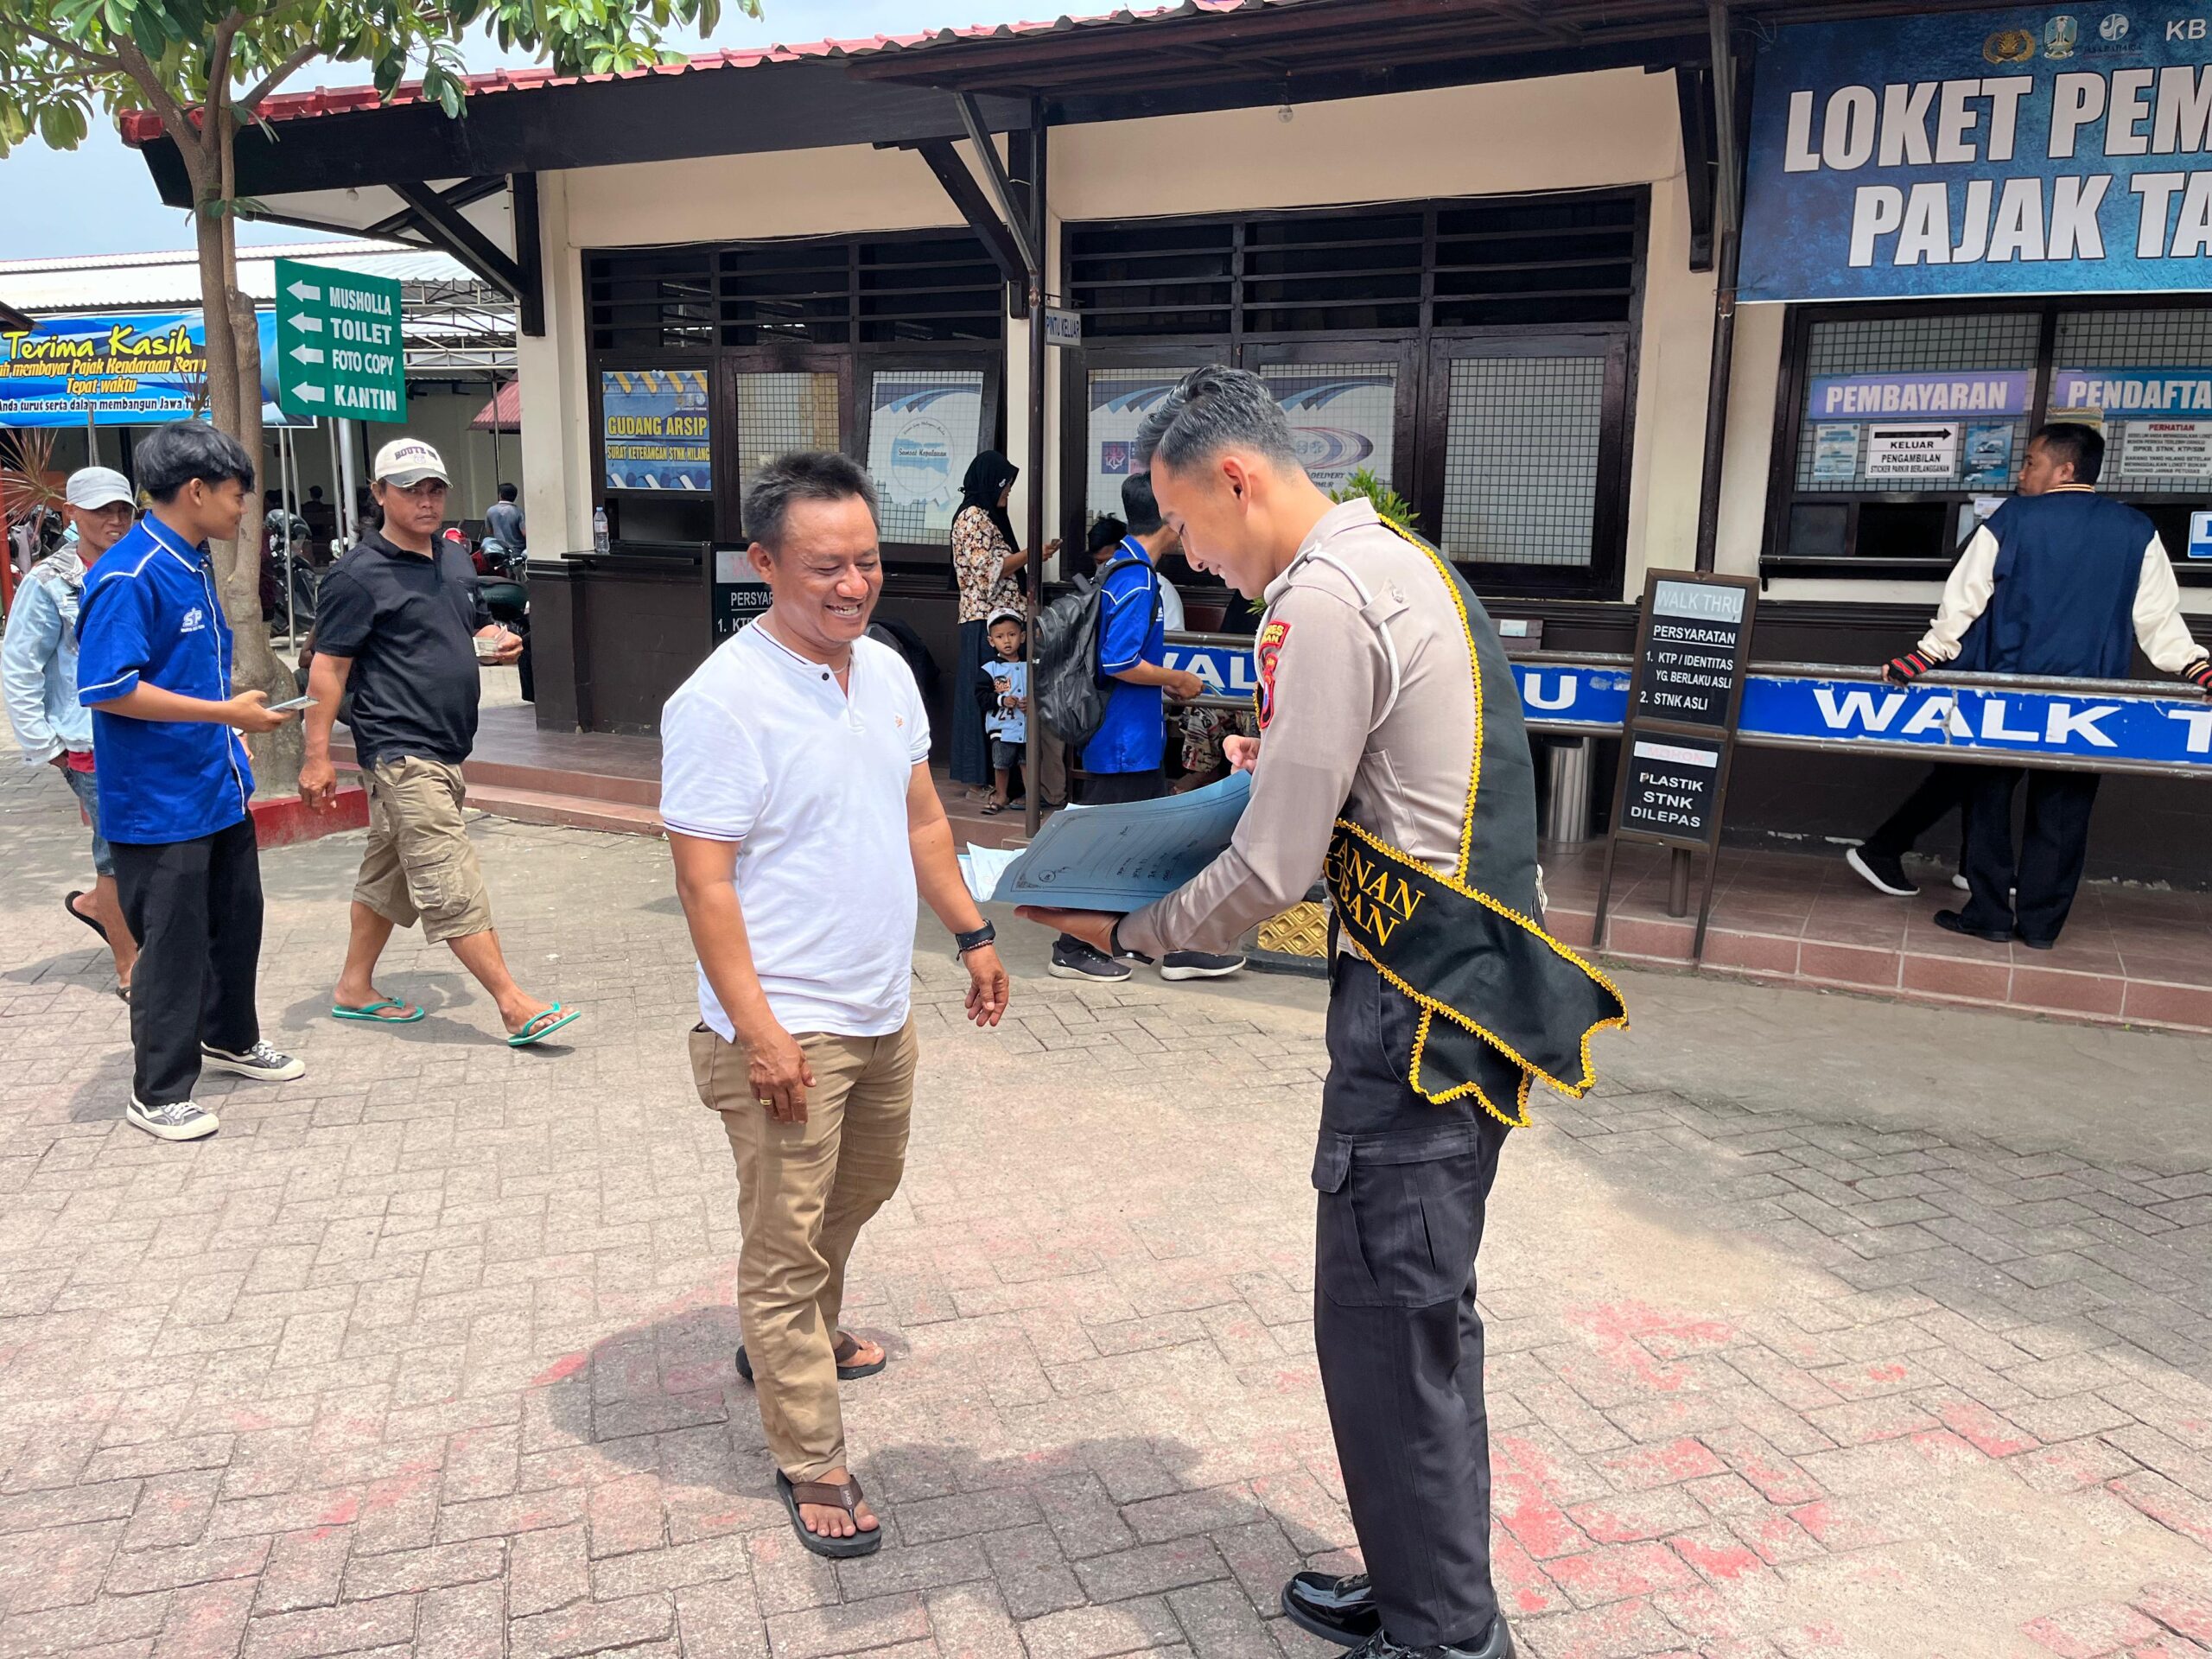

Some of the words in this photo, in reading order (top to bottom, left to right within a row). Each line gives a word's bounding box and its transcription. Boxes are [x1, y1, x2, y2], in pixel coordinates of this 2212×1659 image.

[2166, 19, 2206, 41] KB
[1784, 76, 2033, 172] LOKET
[2049, 65, 2212, 158] PEM
[1848, 175, 2113, 267] PAJAK
[2130, 170, 2212, 258] TA
[329, 286, 391, 316] MUSHOLLA
[330, 317, 392, 346] TOILET
[1046, 315, 1061, 336] PINTU
[1061, 318, 1080, 339] KELUAR
[3, 330, 94, 359] Terima
[109, 323, 192, 356] Kasih
[12, 360, 70, 378] membayar
[72, 358, 104, 377] Pajak
[105, 357, 171, 373] Kendaraan
[332, 349, 362, 372] FOTO
[365, 353, 394, 376] COPY
[67, 378, 98, 396] Tepat
[100, 376, 137, 393] waktu
[2067, 380, 2212, 409] PENDAFTA
[21, 400, 43, 411] turut
[46, 399, 67, 410] serta
[99, 398, 156, 411] membangun
[160, 398, 182, 410] Jawa
[334, 385, 397, 411] KANTIN
[1826, 382, 2007, 413] PEMBAYARAN
[607, 416, 662, 435] GUDANG
[666, 416, 707, 436] ARSIP
[607, 445, 626, 460] SURAT
[629, 446, 667, 460] KETERANGAN
[670, 447, 685, 461] STNK
[687, 447, 709, 461] HILANG
[1881, 454, 1942, 463] PENGAMBILAN
[1658, 590, 1699, 610] WALK
[1703, 594, 1744, 614] THRU
[718, 618, 727, 632] 1.
[1654, 625, 1736, 645] PERSYARATAN
[1646, 651, 1654, 662] 1.
[1658, 652, 1677, 664] KTP
[1684, 654, 1733, 671] IDENTITAS
[1670, 671, 1711, 687] BERLAKU
[1712, 677, 1732, 690] ASLI
[1640, 691, 1649, 703] 2.
[1654, 692, 1682, 708] STNK
[1683, 696, 1708, 710] ASLI
[1813, 688, 2121, 748] WALK
[1639, 772, 1704, 792] PLASTIK
[1643, 791, 1694, 810] STNK
[1630, 806, 1701, 828] DILEPAS
